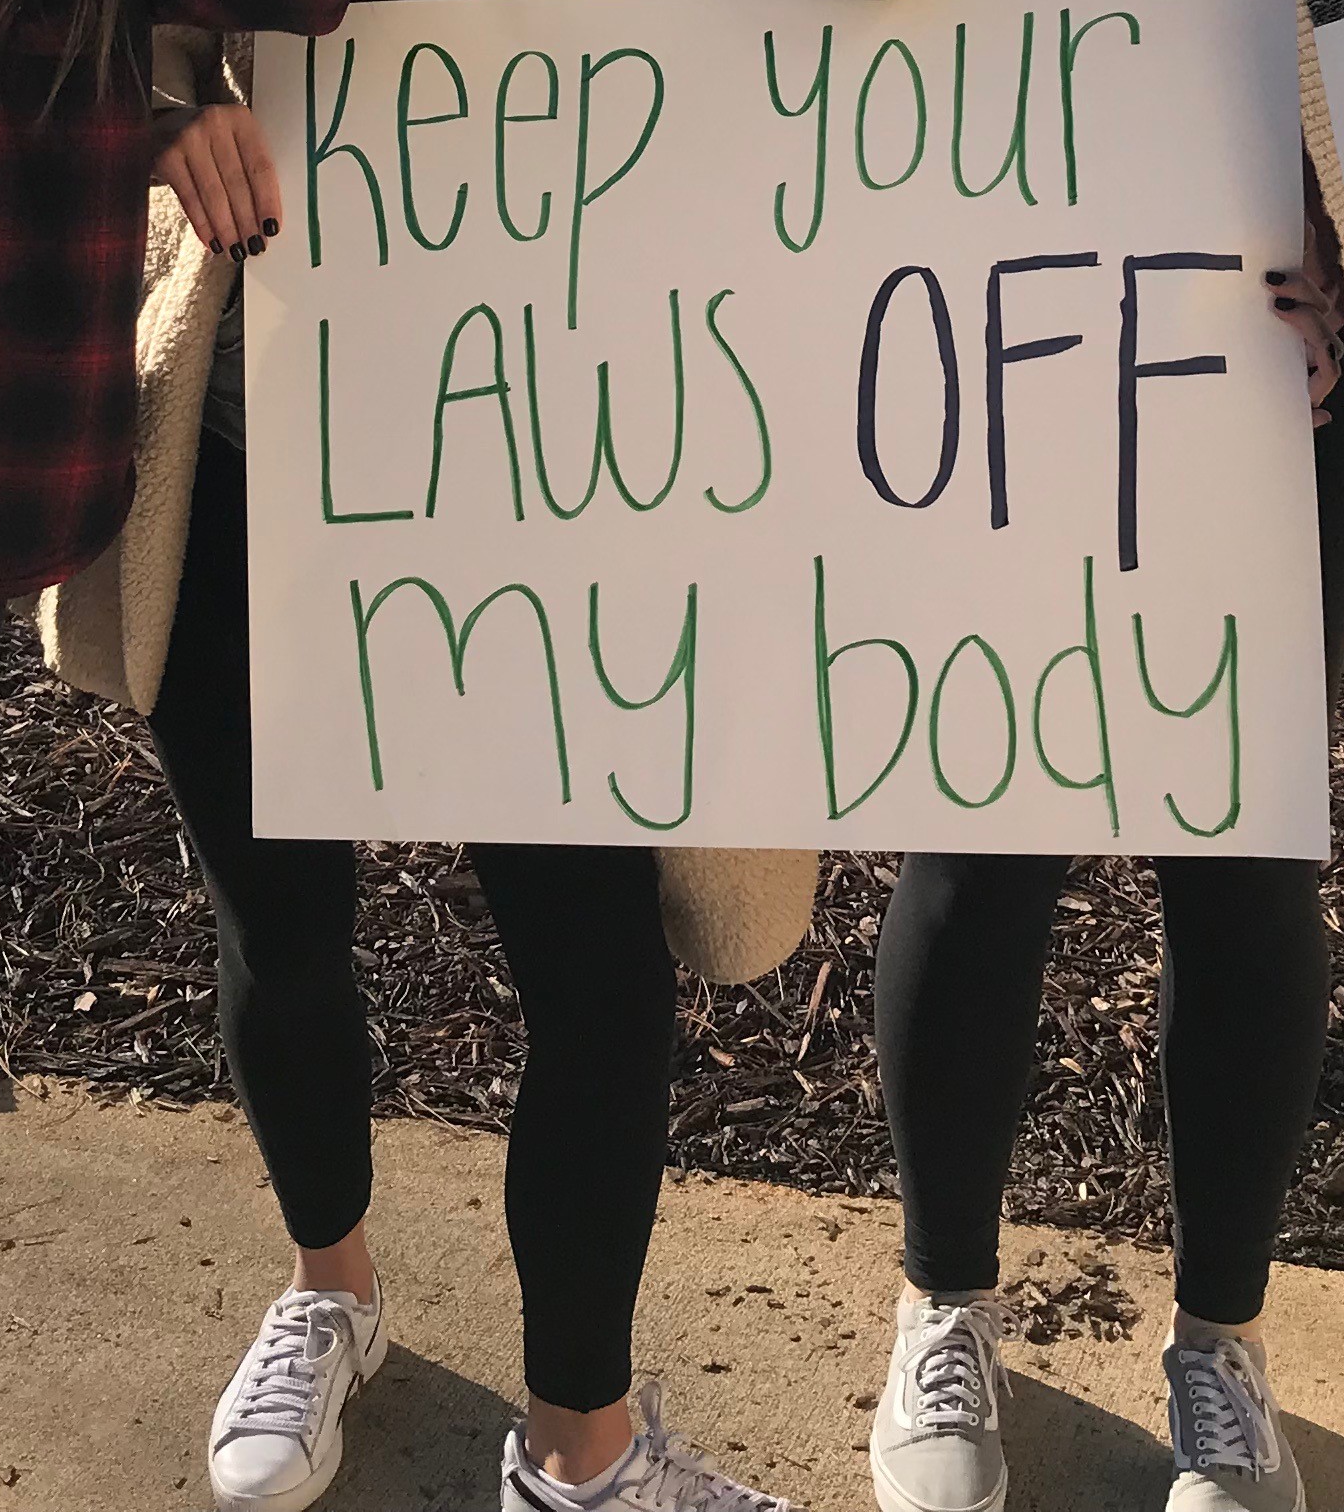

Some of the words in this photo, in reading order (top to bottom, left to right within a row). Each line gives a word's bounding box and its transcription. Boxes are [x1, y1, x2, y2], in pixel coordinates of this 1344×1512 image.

[763, 9, 1141, 253] your
[318, 288, 773, 524] LAWS
[855, 251, 1243, 572] OFF
[350, 576, 698, 830] my
[813, 555, 1240, 838] body
